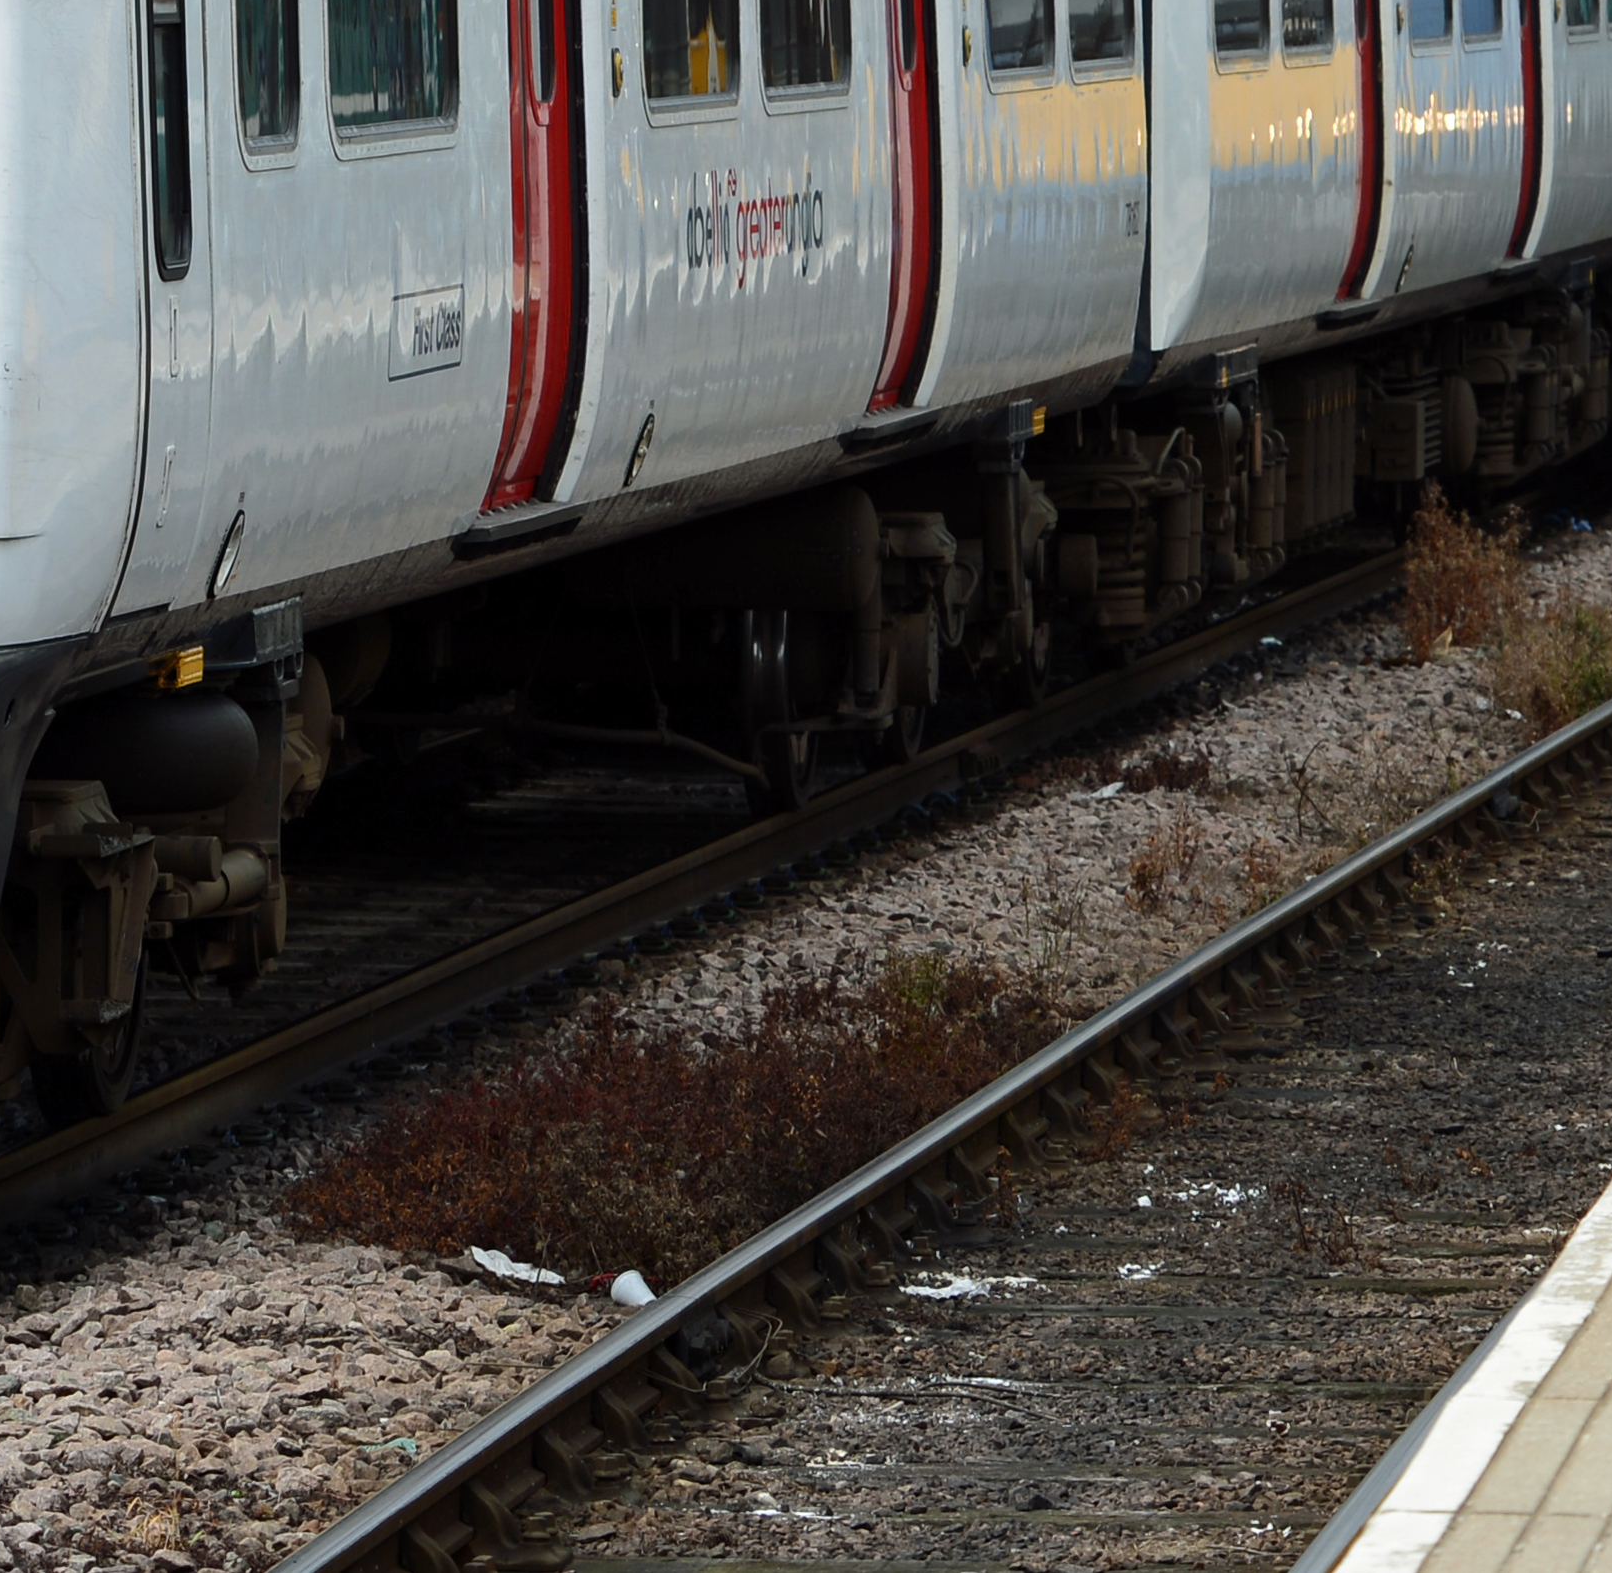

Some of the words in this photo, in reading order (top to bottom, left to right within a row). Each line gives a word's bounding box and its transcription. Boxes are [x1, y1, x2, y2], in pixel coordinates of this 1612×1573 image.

[687, 169, 730, 271] abellio
[413, 306, 435, 357] First
[436, 301, 461, 352] Class
